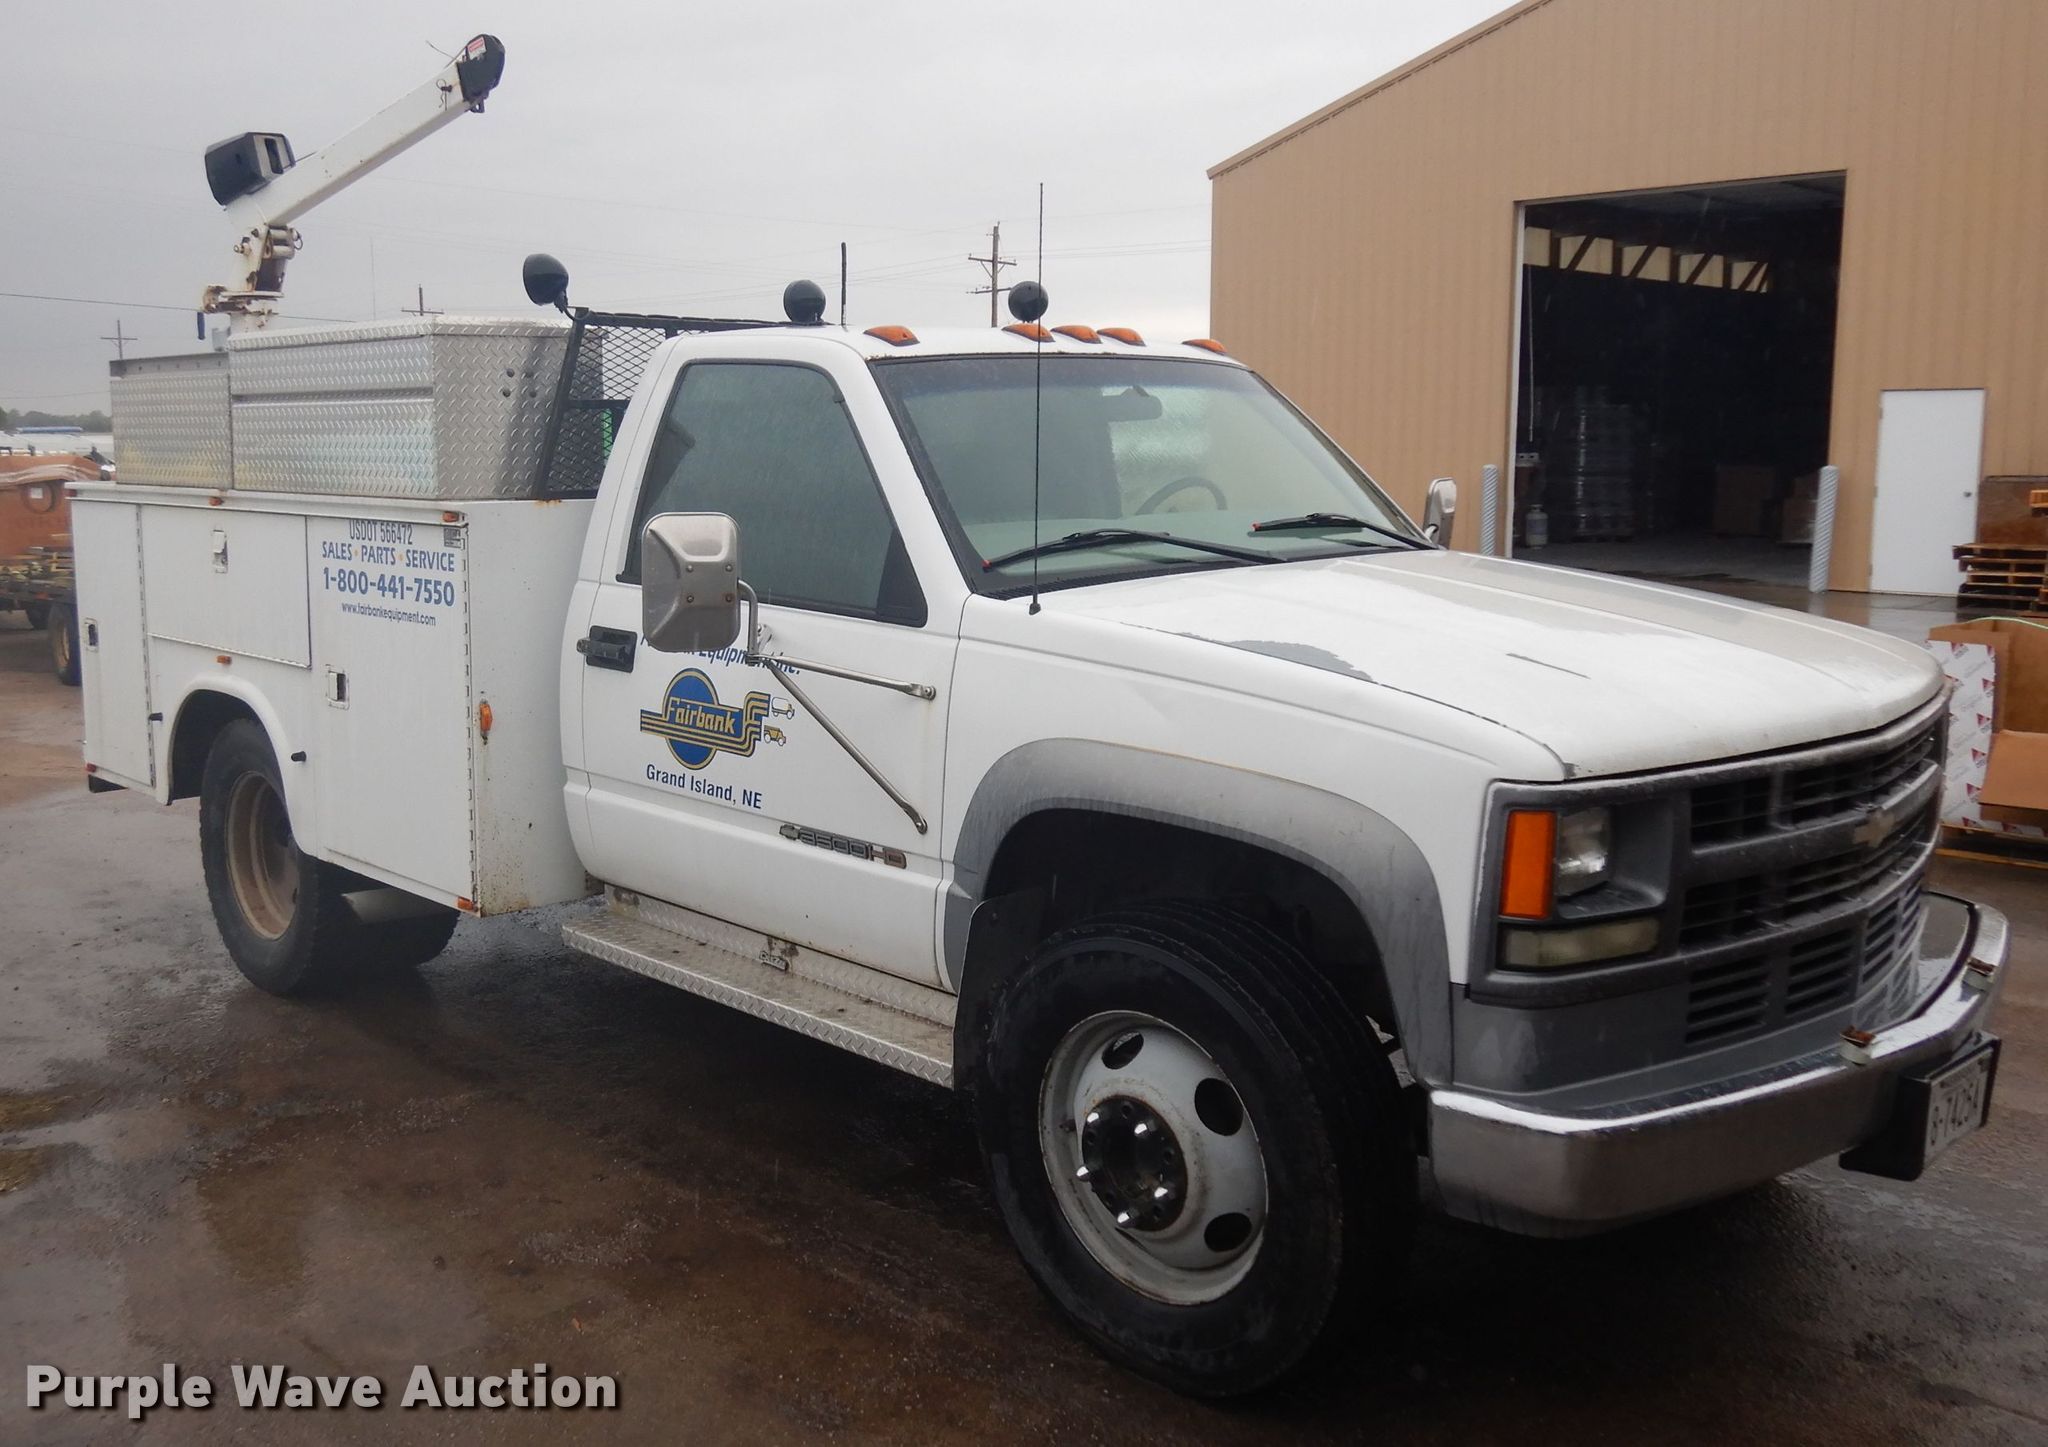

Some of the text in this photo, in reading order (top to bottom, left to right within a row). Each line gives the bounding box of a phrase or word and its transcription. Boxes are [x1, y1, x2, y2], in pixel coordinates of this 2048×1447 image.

[350, 519, 413, 545] USDOT 566472
[322, 541, 455, 572] SALES PARTS SERVICE
[323, 566, 455, 607] 1-800-441-7550
[341, 601, 436, 626] www.fairbankequipment.com
[666, 696, 735, 734] Fairbank
[646, 764, 762, 809] Grand Island, NE
